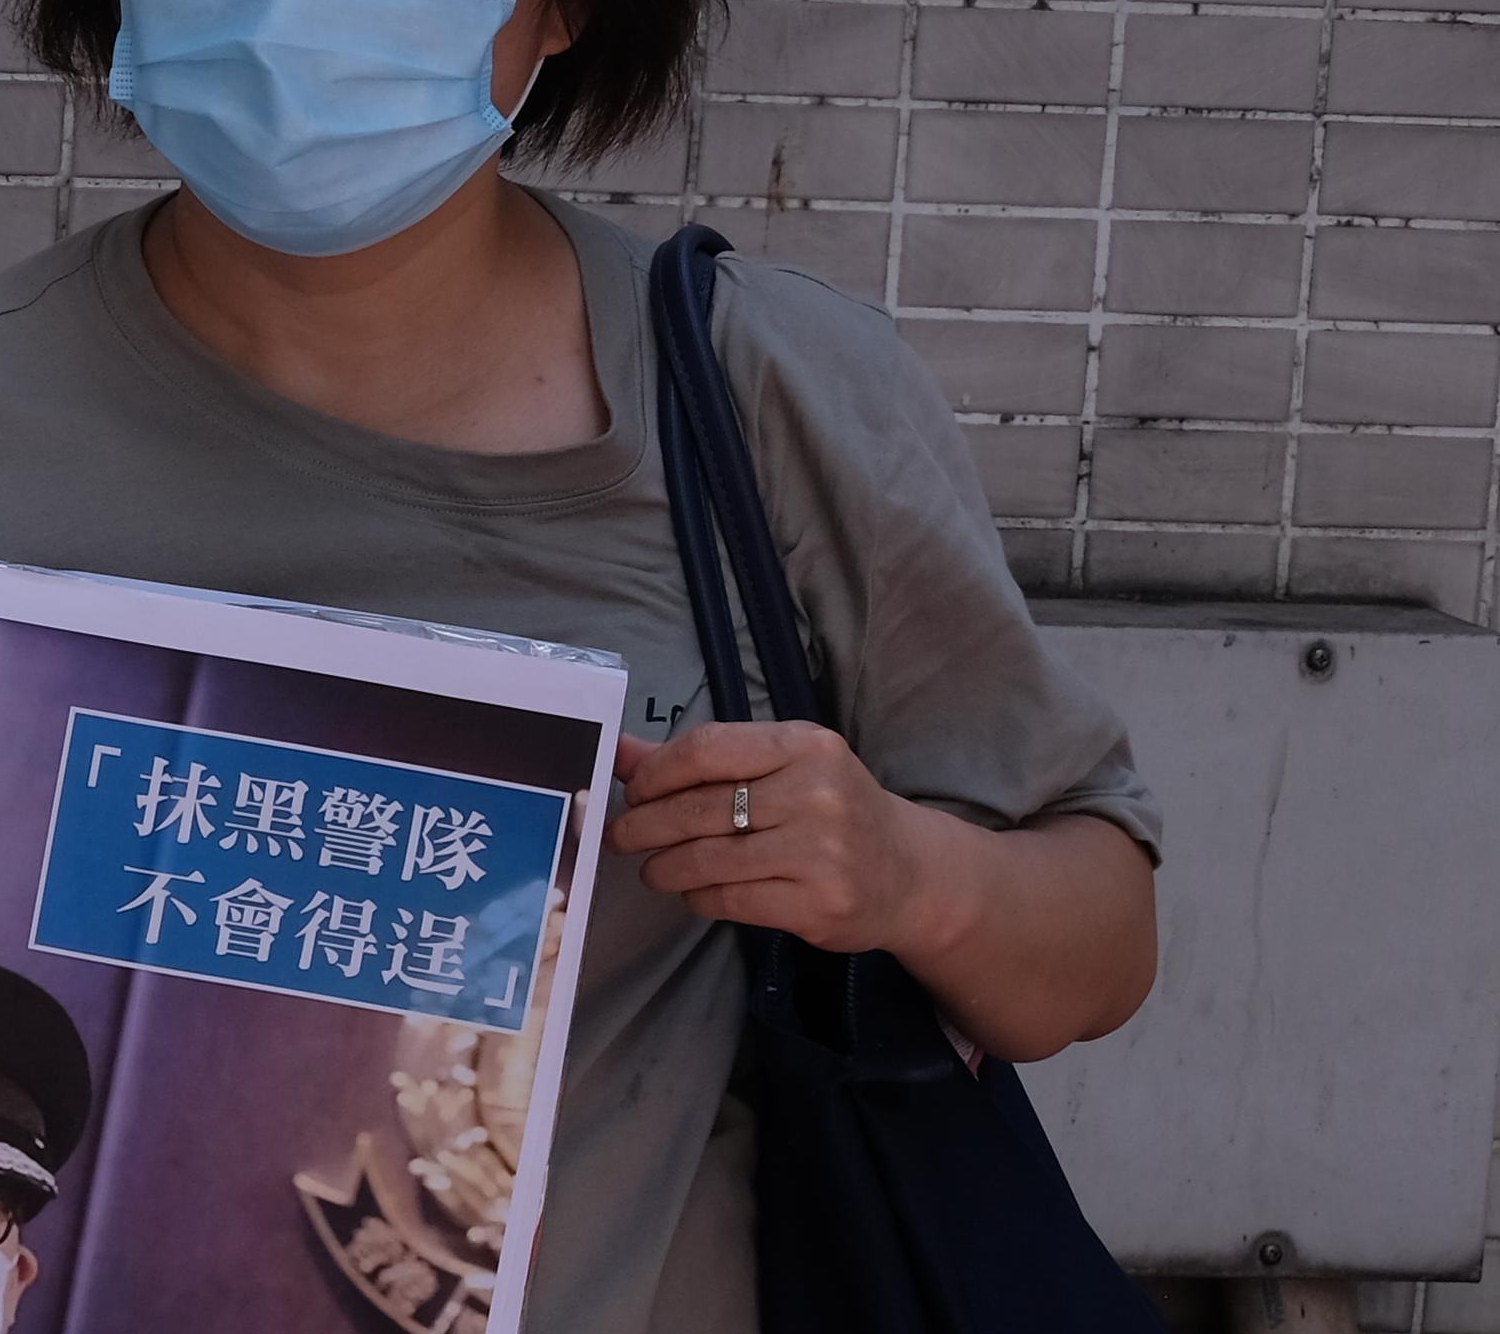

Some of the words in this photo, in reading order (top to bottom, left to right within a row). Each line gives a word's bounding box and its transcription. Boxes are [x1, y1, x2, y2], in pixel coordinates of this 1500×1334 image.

[88, 744, 494, 891] 「抹黑警隊
[116, 864, 520, 1009] 不會得逞」
